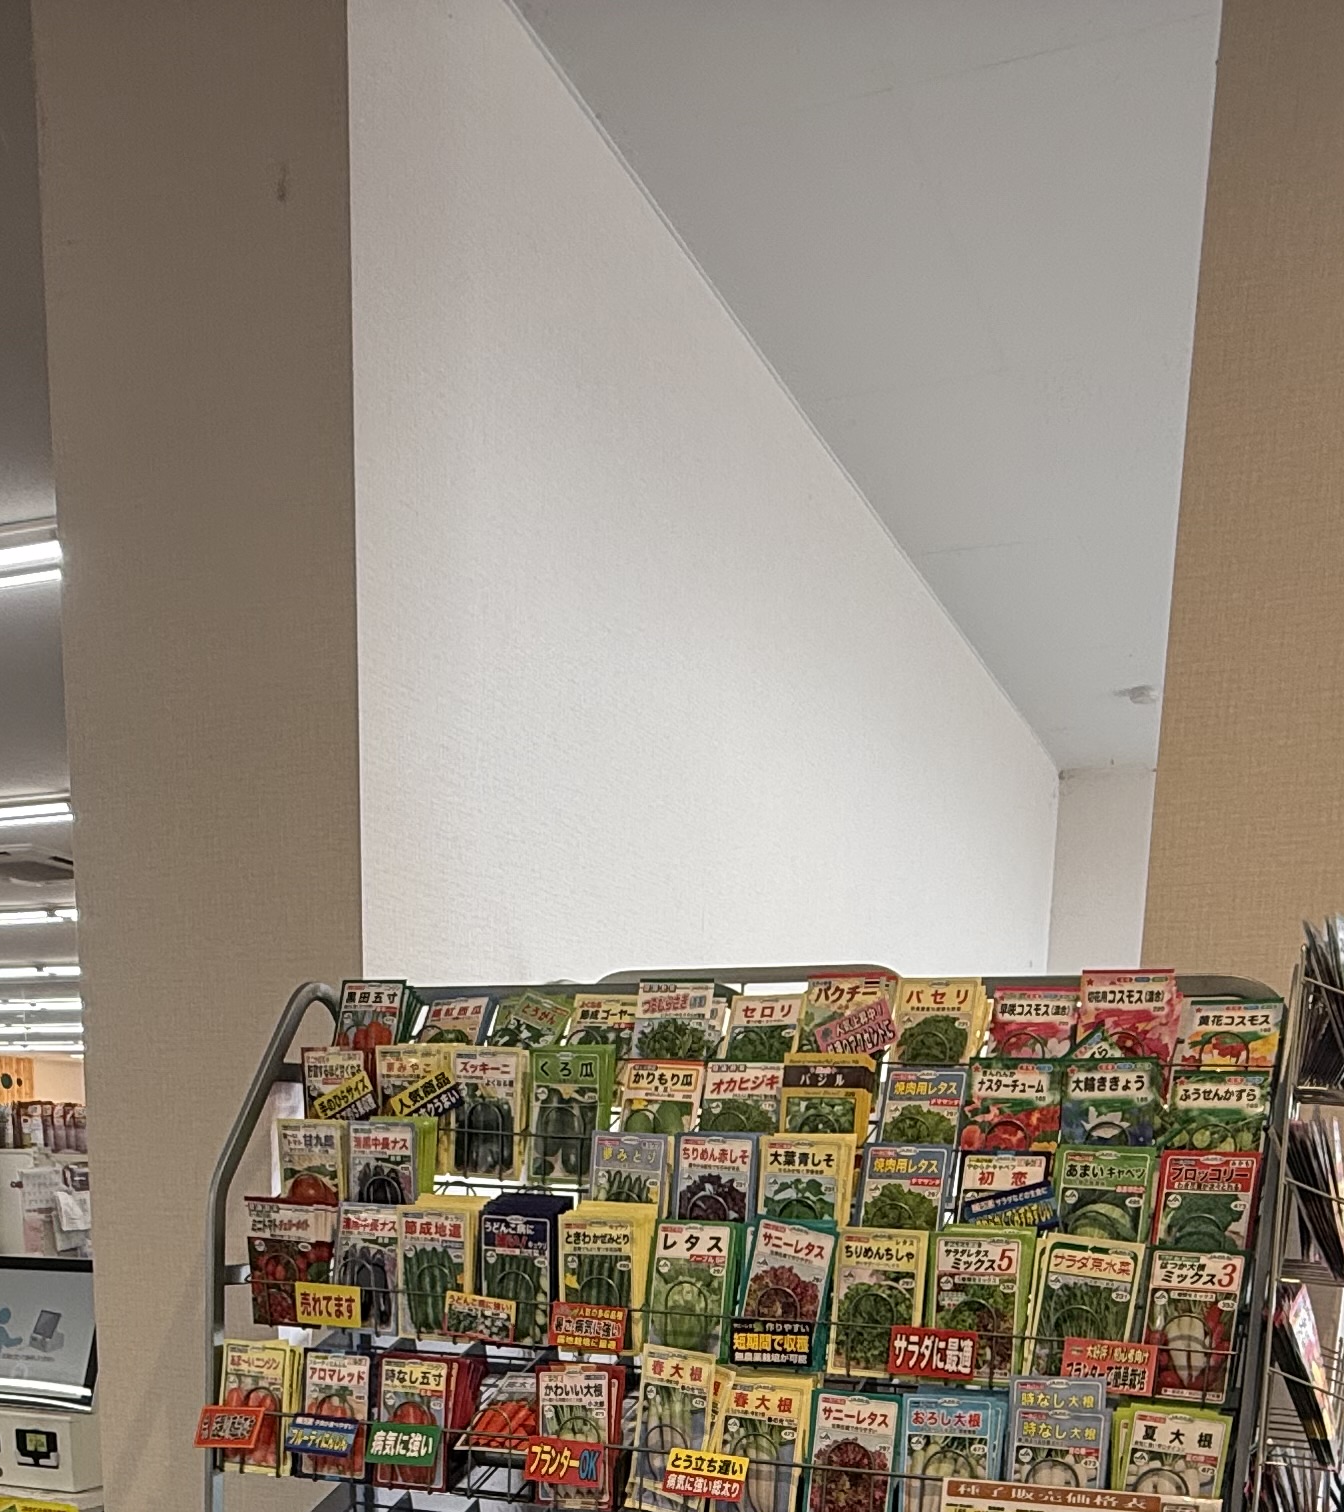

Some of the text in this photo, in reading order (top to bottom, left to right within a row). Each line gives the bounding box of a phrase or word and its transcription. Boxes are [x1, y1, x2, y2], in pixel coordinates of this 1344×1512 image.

[345, 990, 399, 1005] 黒田五寸
[815, 985, 878, 1003] パクチー
[907, 989, 969, 1005] パセリ
[742, 1004, 793, 1019] セロリ
[1197, 1014, 1272, 1028] 黄花コスモス
[459, 1061, 511, 1076] ズッキーニ
[539, 1060, 595, 1078] くろ瓜
[632, 1070, 694, 1087] かりもり瓜
[709, 1073, 781, 1095] オカヒジキ
[799, 1073, 846, 1087] バジル
[893, 1080, 958, 1096] 焼肉用レタス
[976, 1078, 1045, 1094] ナスターチューム
[1071, 1074, 1146, 1093] 大輪ききょう
[395, 1071, 453, 1115] 人気商品
[1179, 1086, 1258, 1103] ふうせんかずら
[682, 1146, 750, 1165] ちりめん赤しそ
[768, 1150, 835, 1168] 大葉青しそ
[872, 1158, 939, 1174] 焼肉用レタス
[1170, 1167, 1250, 1183] ブロッコリー
[662, 1233, 724, 1254] レタス
[761, 1231, 826, 1260] サニーレタス
[950, 1257, 998, 1272] ミックス
[997, 1248, 1017, 1272] 5
[1052, 1252, 1132, 1278] サラダ京水菜
[1160, 1270, 1216, 1286] ミックス
[1216, 1263, 1238, 1289] 3
[299, 1291, 357, 1321] 売れてます
[764, 1321, 811, 1334] 作りやすい
[732, 1333, 810, 1354] 短期間で収穫
[893, 1333, 975, 1376] サラダに最適
[308, 1366, 367, 1386] アロマレッド
[384, 1369, 445, 1387] 時なし五寸
[650, 1359, 704, 1383] 春大根
[544, 1382, 604, 1398] かわいい大根
[732, 1390, 794, 1414] 春大根
[821, 1405, 890, 1429] サニーレタス
[911, 1409, 983, 1430] おろし大根
[1022, 1420, 1097, 1442] 時なし大根
[1141, 1424, 1214, 1450] 夏大根
[369, 1429, 434, 1458] 病気に強い
[529, 1445, 601, 1481] プランターOK
[670, 1453, 744, 1476] とう立ち遅い
[665, 1472, 740, 1498] 病気に強い総太り
